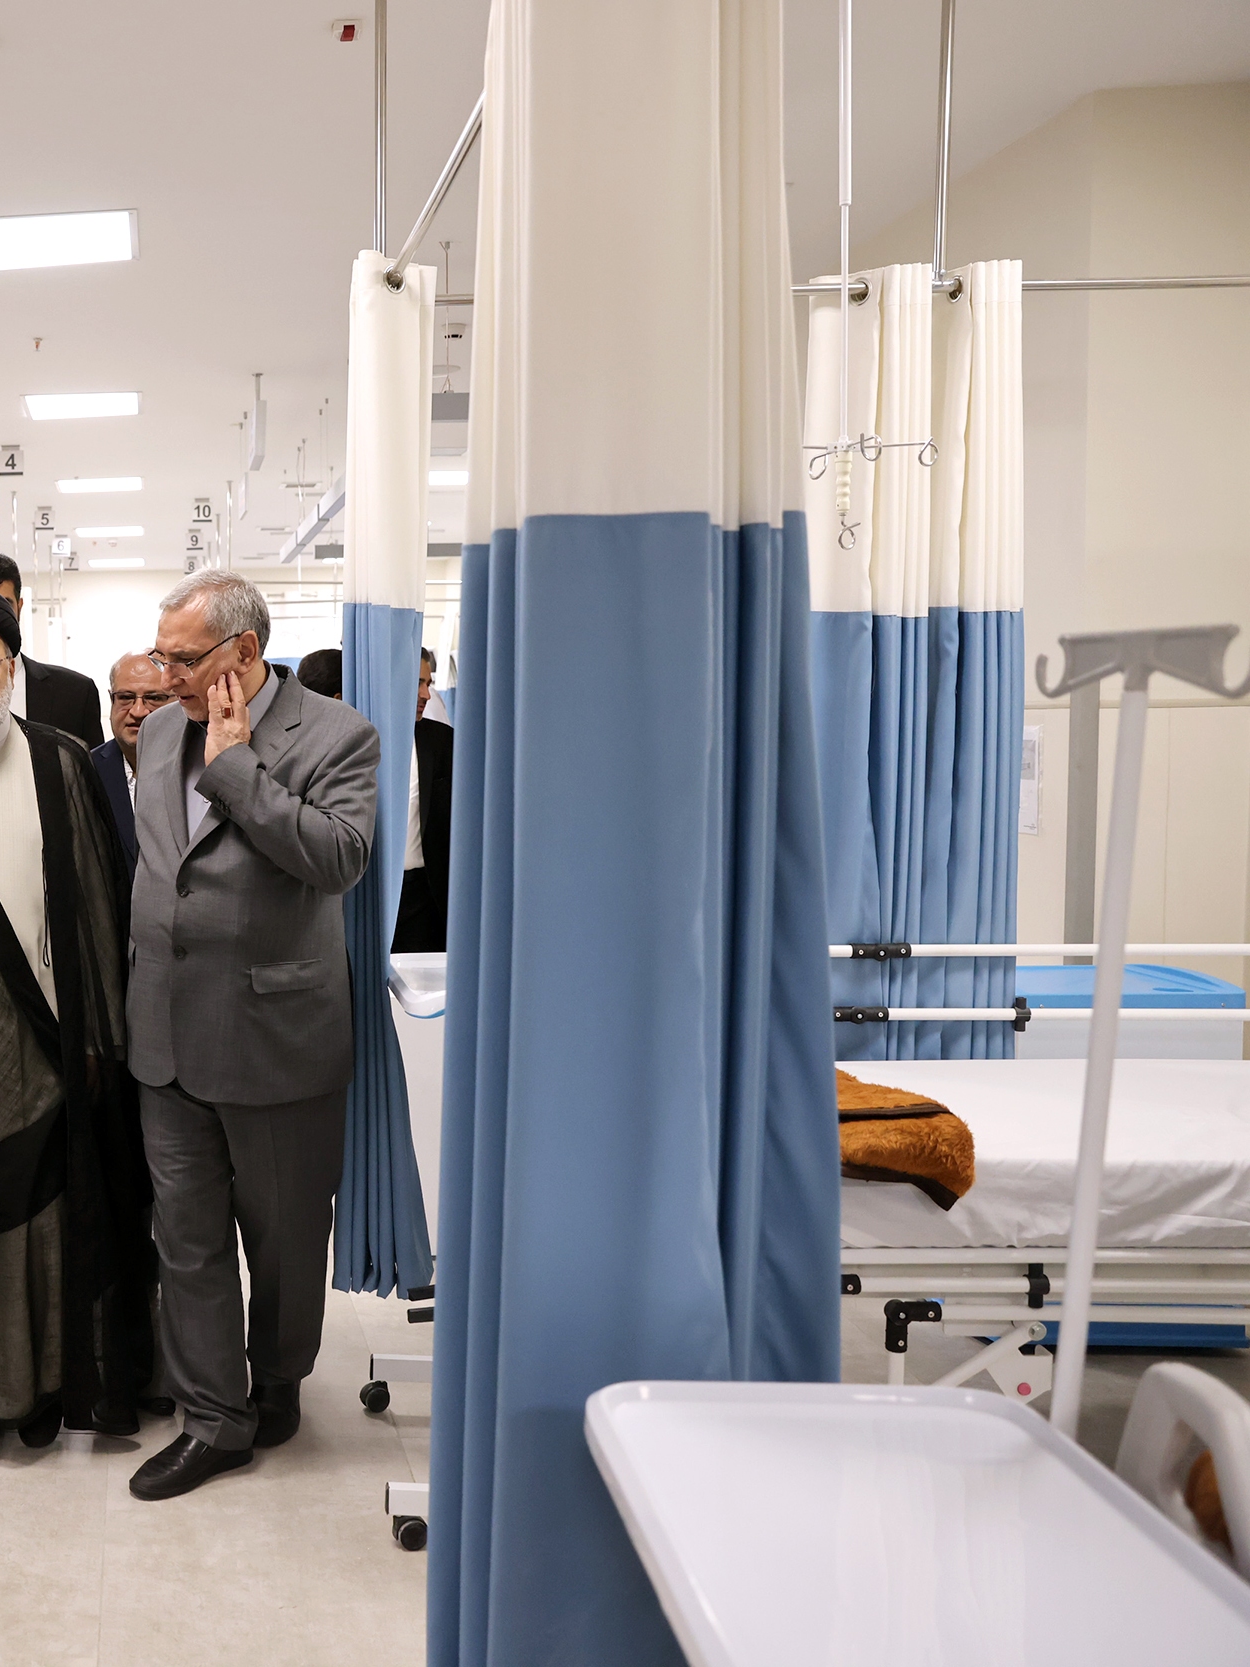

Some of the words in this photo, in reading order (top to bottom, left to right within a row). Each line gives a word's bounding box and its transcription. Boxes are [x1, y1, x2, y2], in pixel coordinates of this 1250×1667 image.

[5, 453, 17, 470] 4
[194, 504, 211, 518] 10
[40, 513, 50, 526] 5
[57, 540, 65, 551] 6
[190, 534, 199, 547] 9
[68, 557, 75, 568] 7
[187, 561, 195, 572] 8
